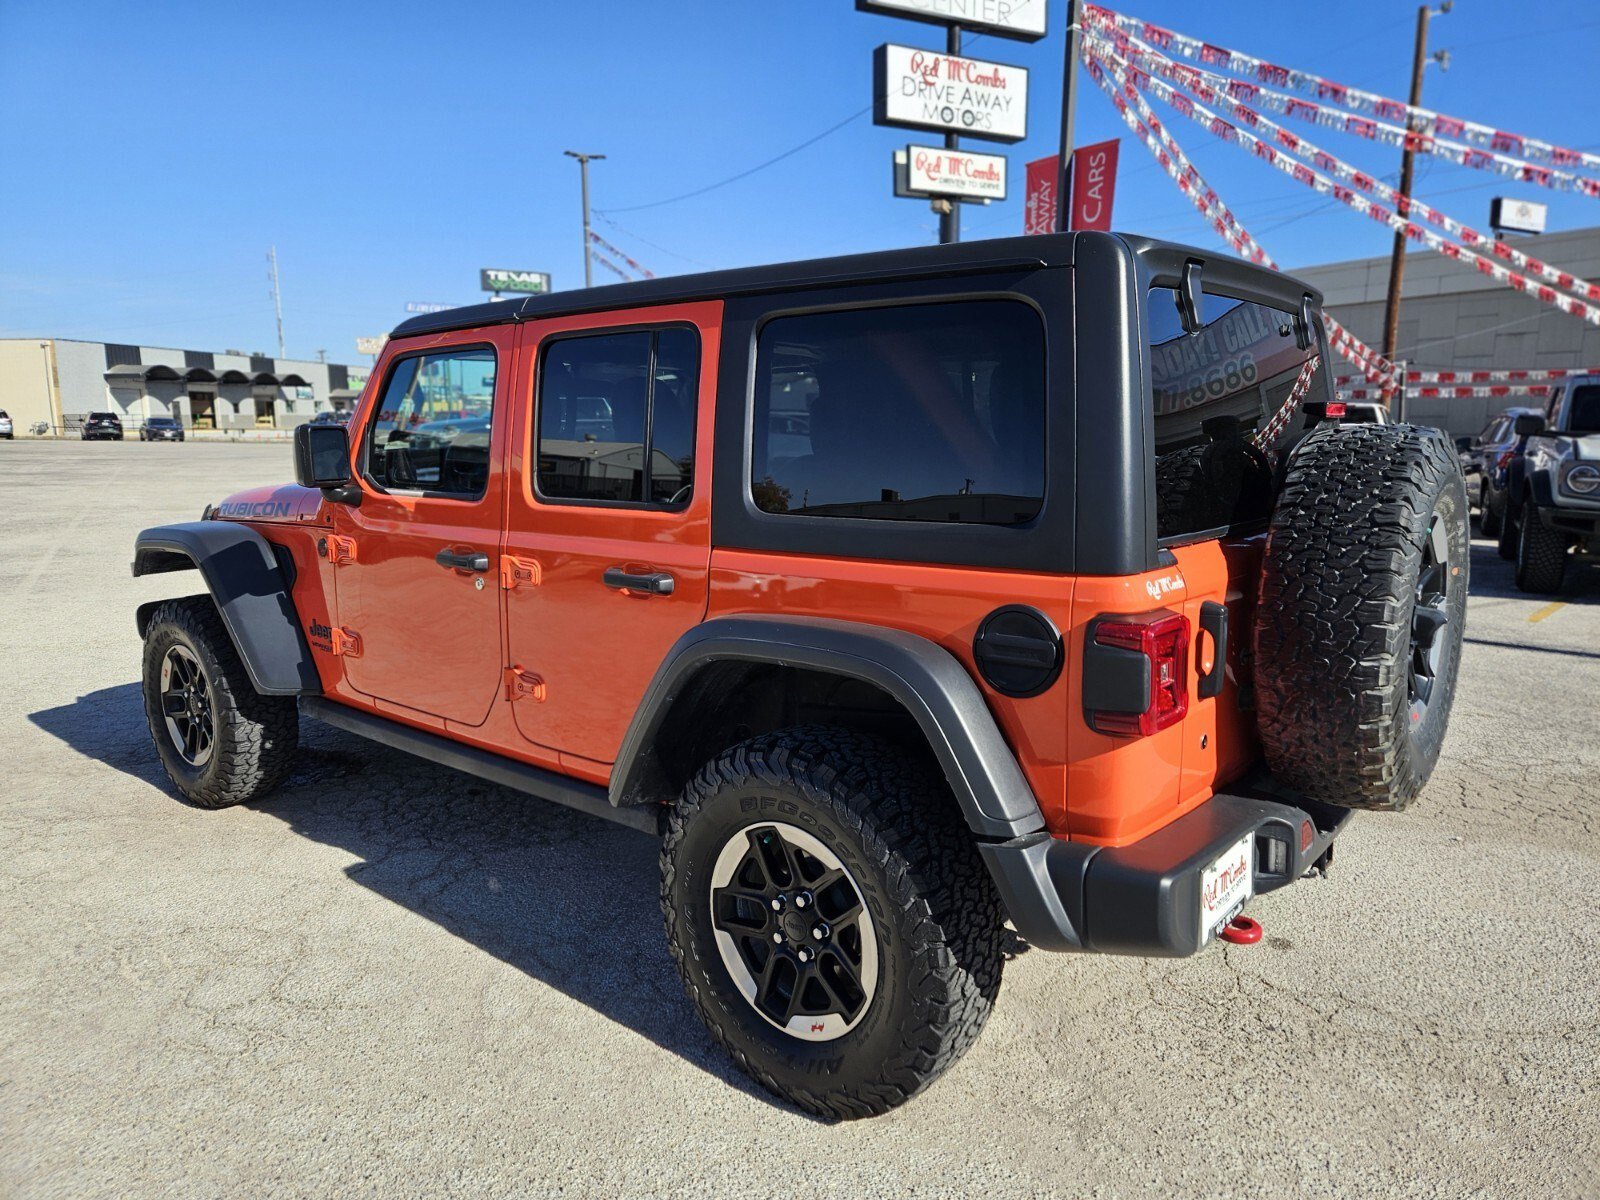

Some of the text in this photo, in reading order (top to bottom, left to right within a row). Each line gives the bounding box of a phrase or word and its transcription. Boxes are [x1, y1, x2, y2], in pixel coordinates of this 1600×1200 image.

[911, 51, 1006, 90] Red McCombs
[902, 76, 1012, 112] DRIVE AWAY
[922, 103, 992, 130] MOTORS
[915, 151, 1000, 182] Red McCombs
[1083, 152, 1106, 223] CARS
[1036, 180, 1051, 235] AWAY
[486, 270, 541, 283] TEXAS
[1222, 304, 1269, 353] CALL
[219, 502, 291, 517] RUBICON
[309, 618, 332, 644] Jeep
